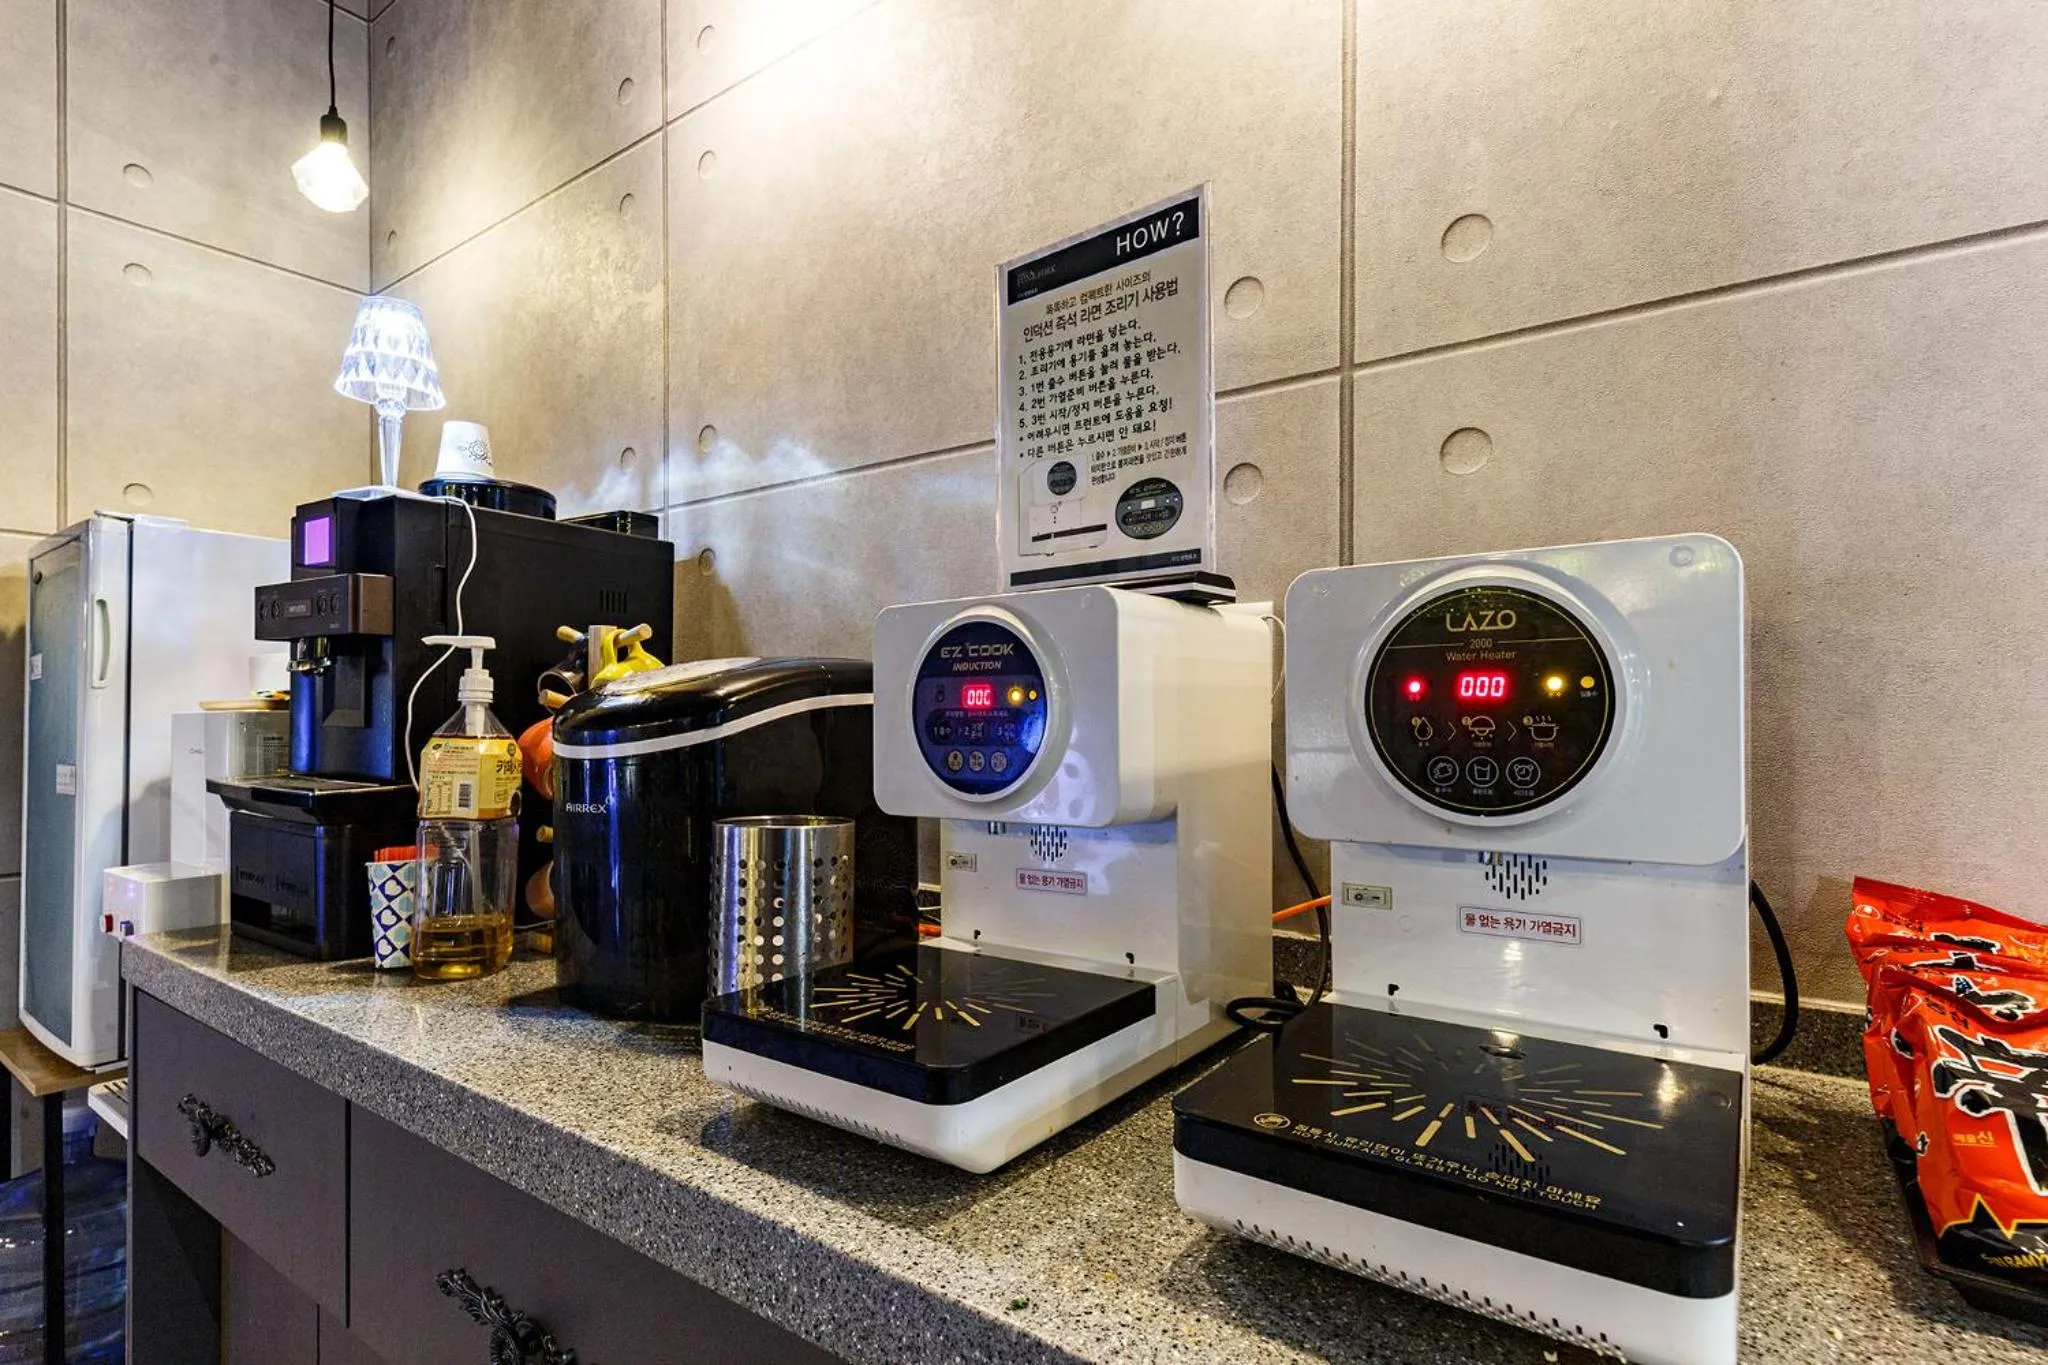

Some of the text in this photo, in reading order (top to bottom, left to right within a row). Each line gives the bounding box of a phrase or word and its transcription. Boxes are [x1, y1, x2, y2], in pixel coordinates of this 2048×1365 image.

[1115, 211, 1185, 256] HOW?
[1116, 269, 1151, 291] 사이즈의
[1023, 276, 1178, 343] 인덕션 즉석 라면 조리기 사용법
[1030, 339, 1073, 362] 전용용기에
[1077, 329, 1104, 345] 라면을
[1108, 318, 1141, 338] 넣는다.
[1019, 370, 1027, 380] 2.
[1030, 358, 1065, 376] 조리기에
[1069, 348, 1097, 368] 용기를
[1101, 341, 1119, 358] 올려
[1019, 386, 1027, 396] 3.
[1031, 380, 1044, 393] 1번
[1069, 366, 1095, 382] 버튼을
[1146, 342, 1181, 362] 받는다.
[1019, 368, 1153, 411] 4. 2번 가열준비 버튼을 누른다.
[1019, 384, 1159, 428] 5. 3번 시작/정지 버튼을 누른다.
[1027, 422, 1070, 441] 어려우시면
[1114, 404, 1144, 421] 도움을
[1148, 397, 1172, 413] 요청!
[1028, 445, 1044, 458] 다른
[1048, 438, 1074, 454] 버튼은
[1077, 429, 1115, 447] 누르시면
[1118, 425, 1128, 440] 안
[1446, 609, 1516, 632] LAZO
[941, 648, 962, 658] EZ
[1446, 650, 1517, 661] Water Heater
[1470, 638, 1493, 649] 2000
[952, 661, 1002, 672] INDUCTION
[1461, 676, 1505, 697] 000
[566, 802, 607, 813] AIRREX
[1056, 877, 1084, 889] 가열금지
[1465, 913, 1577, 938] 물 없는 용기 가열금지
[1292, 1129, 1320, 1140] HOT
[1324, 1137, 1389, 1158] SURFACE
[1467, 1173, 1489, 1183] DO
[1496, 1181, 1528, 1194] NOT
[1539, 1191, 1598, 1211] TOUCH
[1546, 1185, 1601, 1204] 마세요
[2003, 1251, 2048, 1271] RAMY
